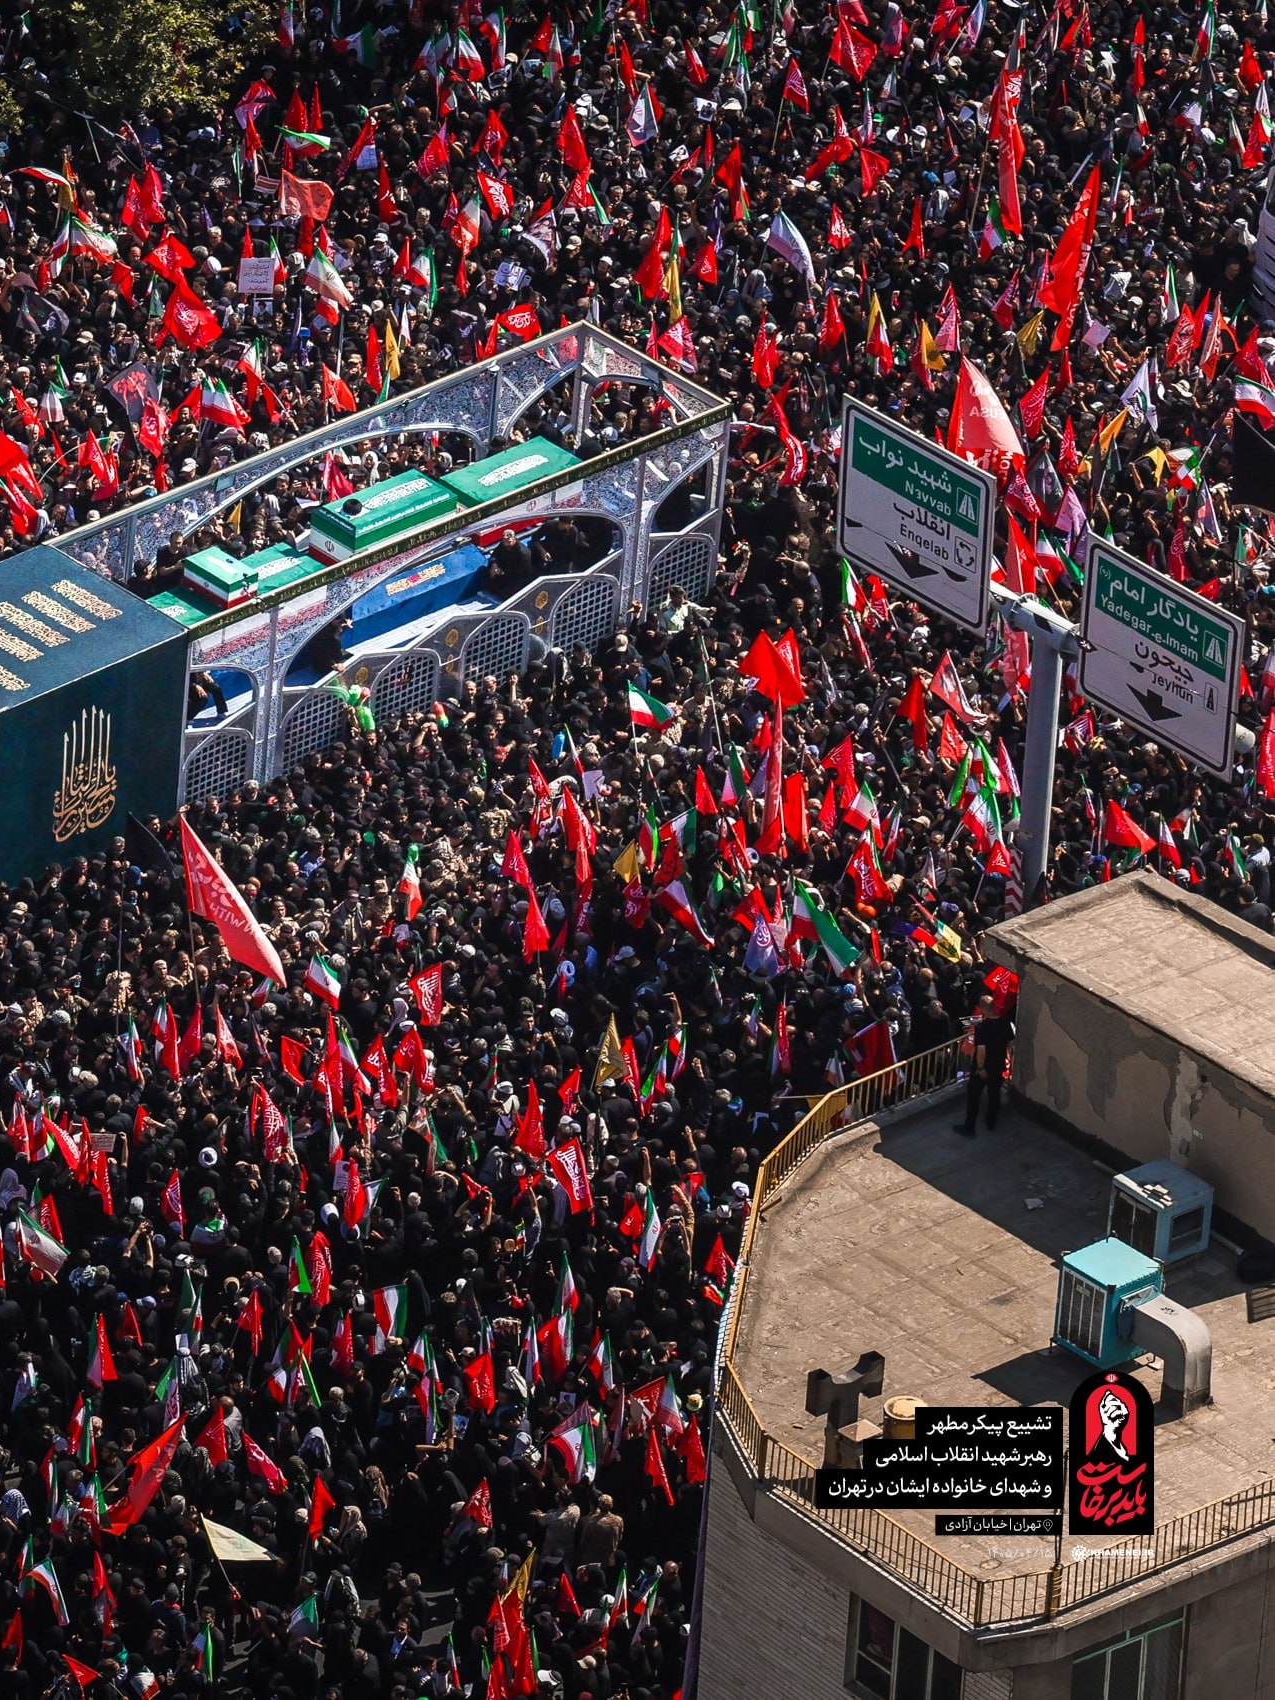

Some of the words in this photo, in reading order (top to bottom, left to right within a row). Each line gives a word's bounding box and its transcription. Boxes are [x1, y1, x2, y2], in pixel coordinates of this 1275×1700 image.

[859, 436, 904, 469] نواب
[908, 461, 952, 493] شهید
[893, 502, 951, 540] انقلاب
[900, 523, 949, 561] Enqelab
[1109, 576, 1145, 604] امام
[1146, 598, 1199, 642] یادگار
[1134, 641, 1195, 684] جیحون
[1151, 672, 1194, 704] Jeyhun
